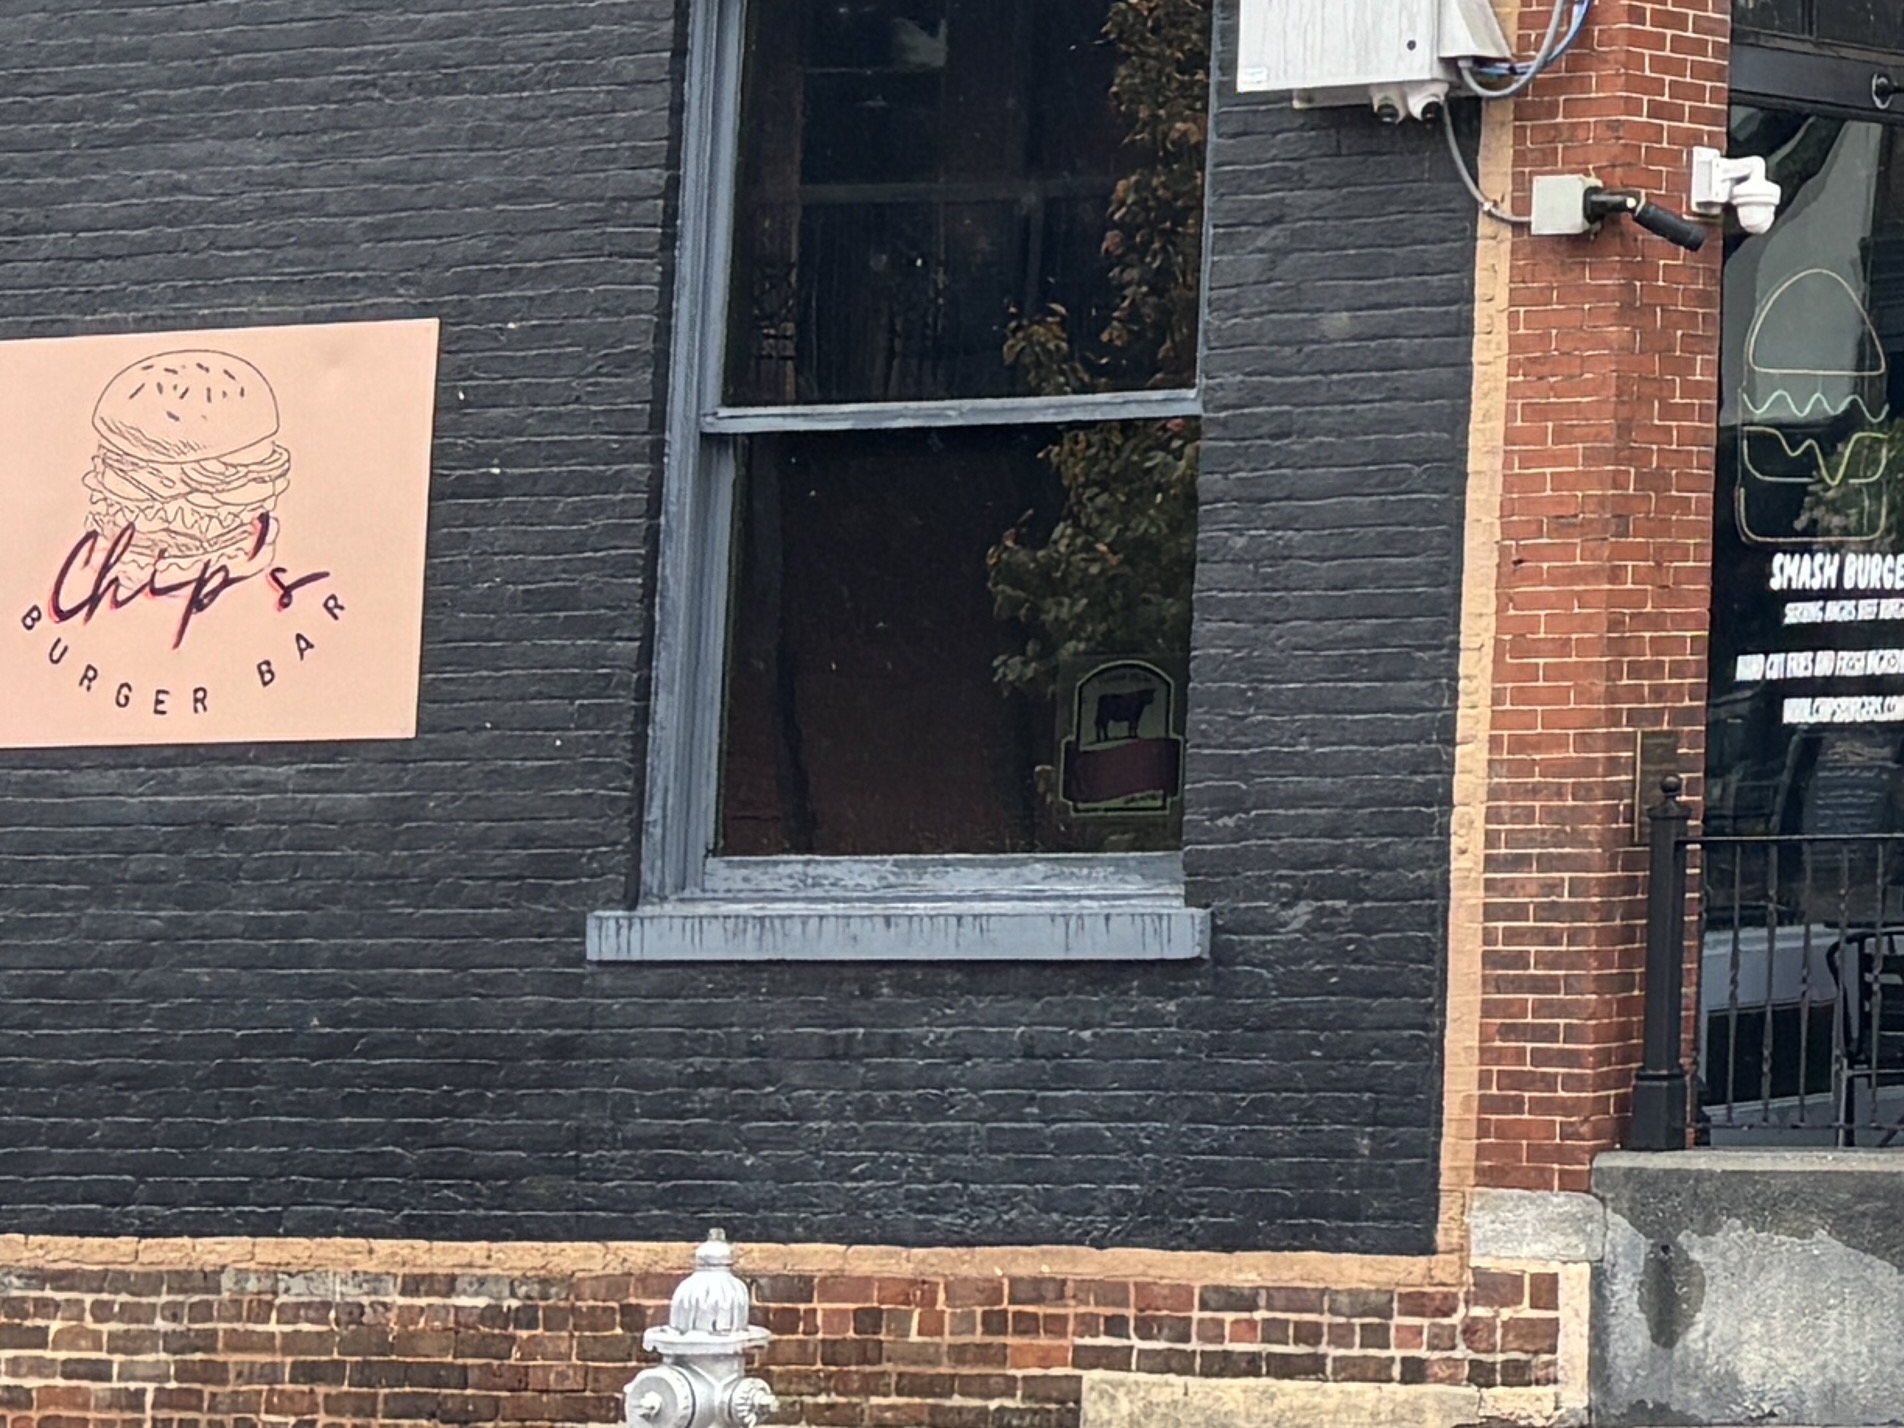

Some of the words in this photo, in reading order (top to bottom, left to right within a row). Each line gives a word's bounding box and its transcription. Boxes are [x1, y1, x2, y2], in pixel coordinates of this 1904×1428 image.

[49, 511, 331, 650] Chip's
[1769, 552, 1840, 591] SMASH
[20, 604, 209, 716] BURGER
[256, 593, 347, 689] BAR
